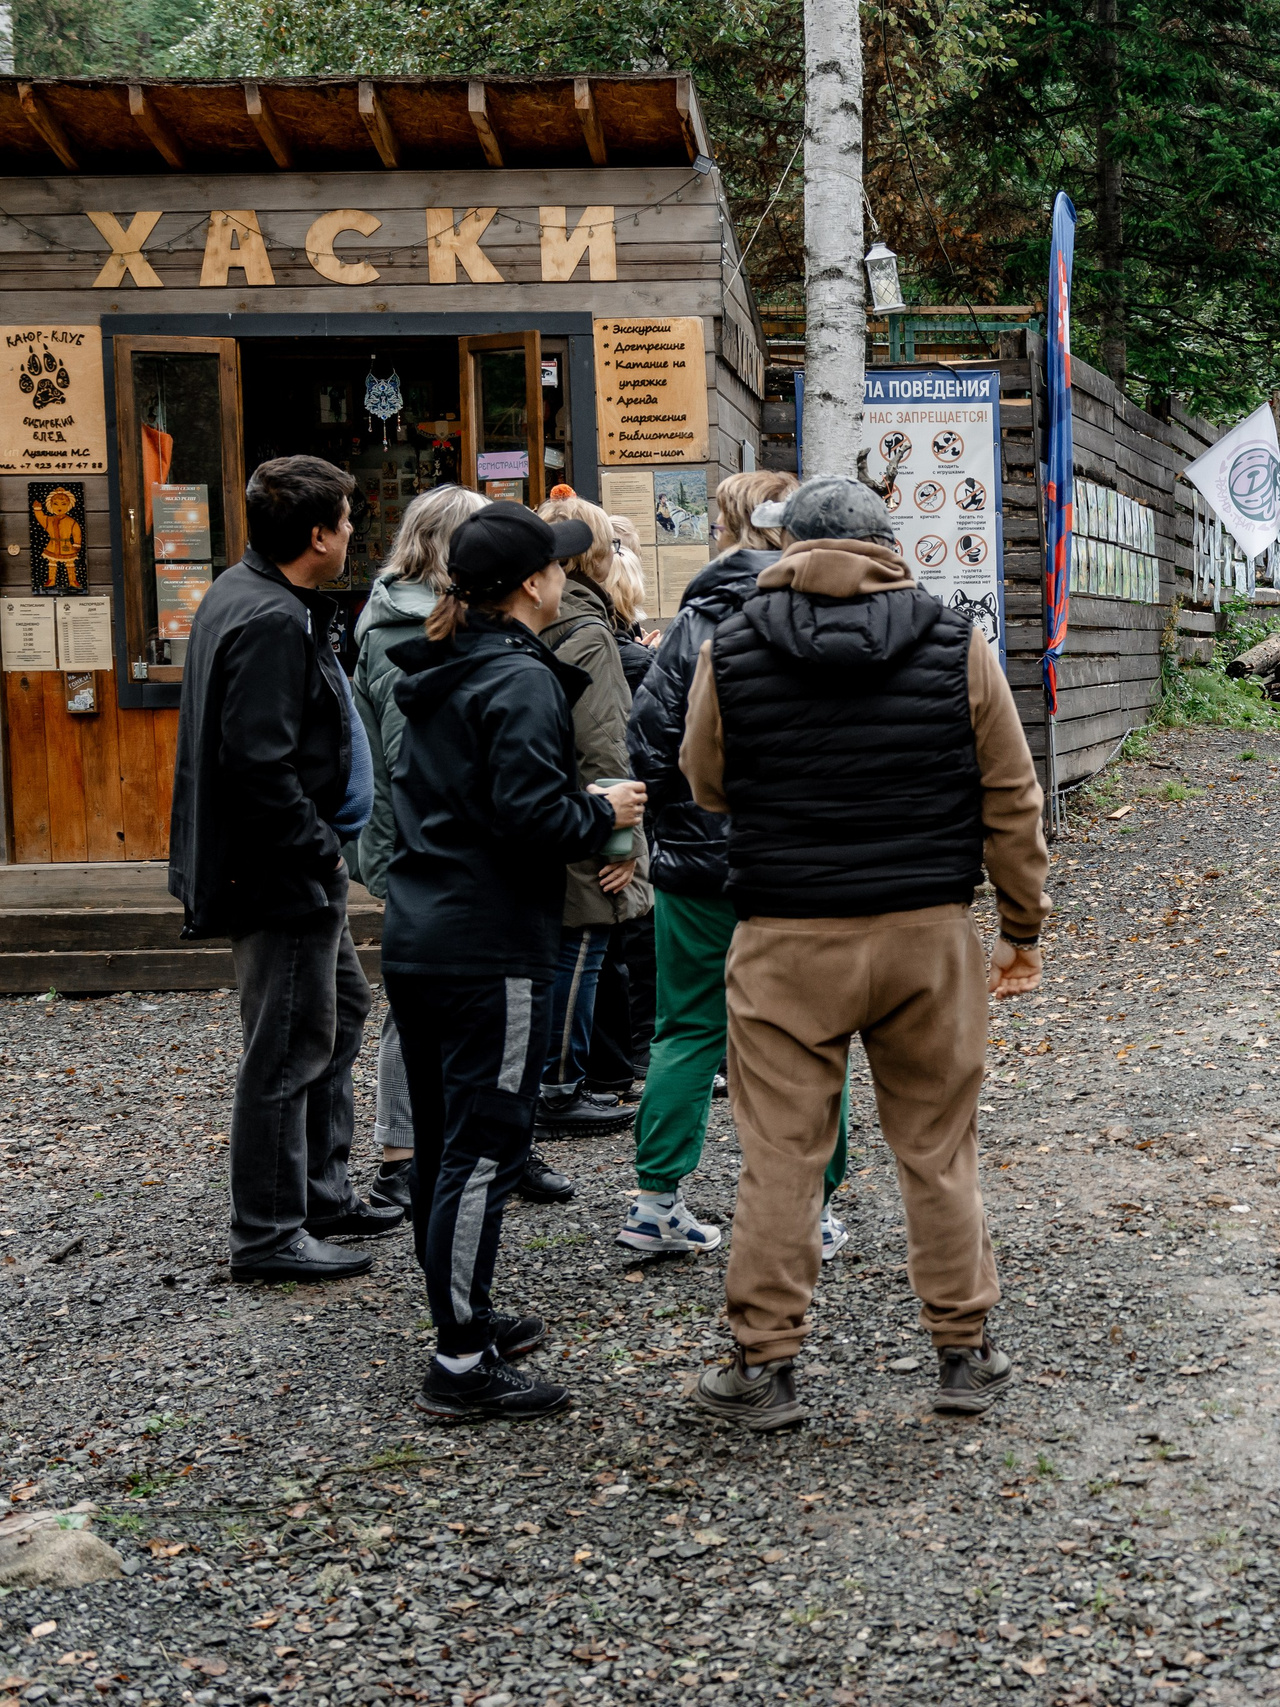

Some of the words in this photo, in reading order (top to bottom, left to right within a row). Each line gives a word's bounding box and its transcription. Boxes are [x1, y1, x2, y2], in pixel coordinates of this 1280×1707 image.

[86, 206, 617, 288] ХАСКИ
[612, 324, 672, 336] Экскурсии
[6, 330, 85, 348] КАЮР-КЛУБ
[614, 342, 686, 354] Догтрекинг
[615, 360, 669, 370] Катание
[673, 360, 686, 368] на
[618, 378, 667, 390] упряжке
[889, 379, 990, 400] ПОВЕДЕНИЯ
[617, 394, 658, 407] Аренда
[620, 413, 687, 425] снаряжения
[869, 411, 893, 424] НАС
[896, 410, 988, 425] ЗАПРЕЩАЕТСЯ!
[618, 429, 694, 441] Библиотечка
[619, 448, 685, 459] Хаски-шоп
[478, 460, 529, 471] РЕГИСТРАЦИЯ
